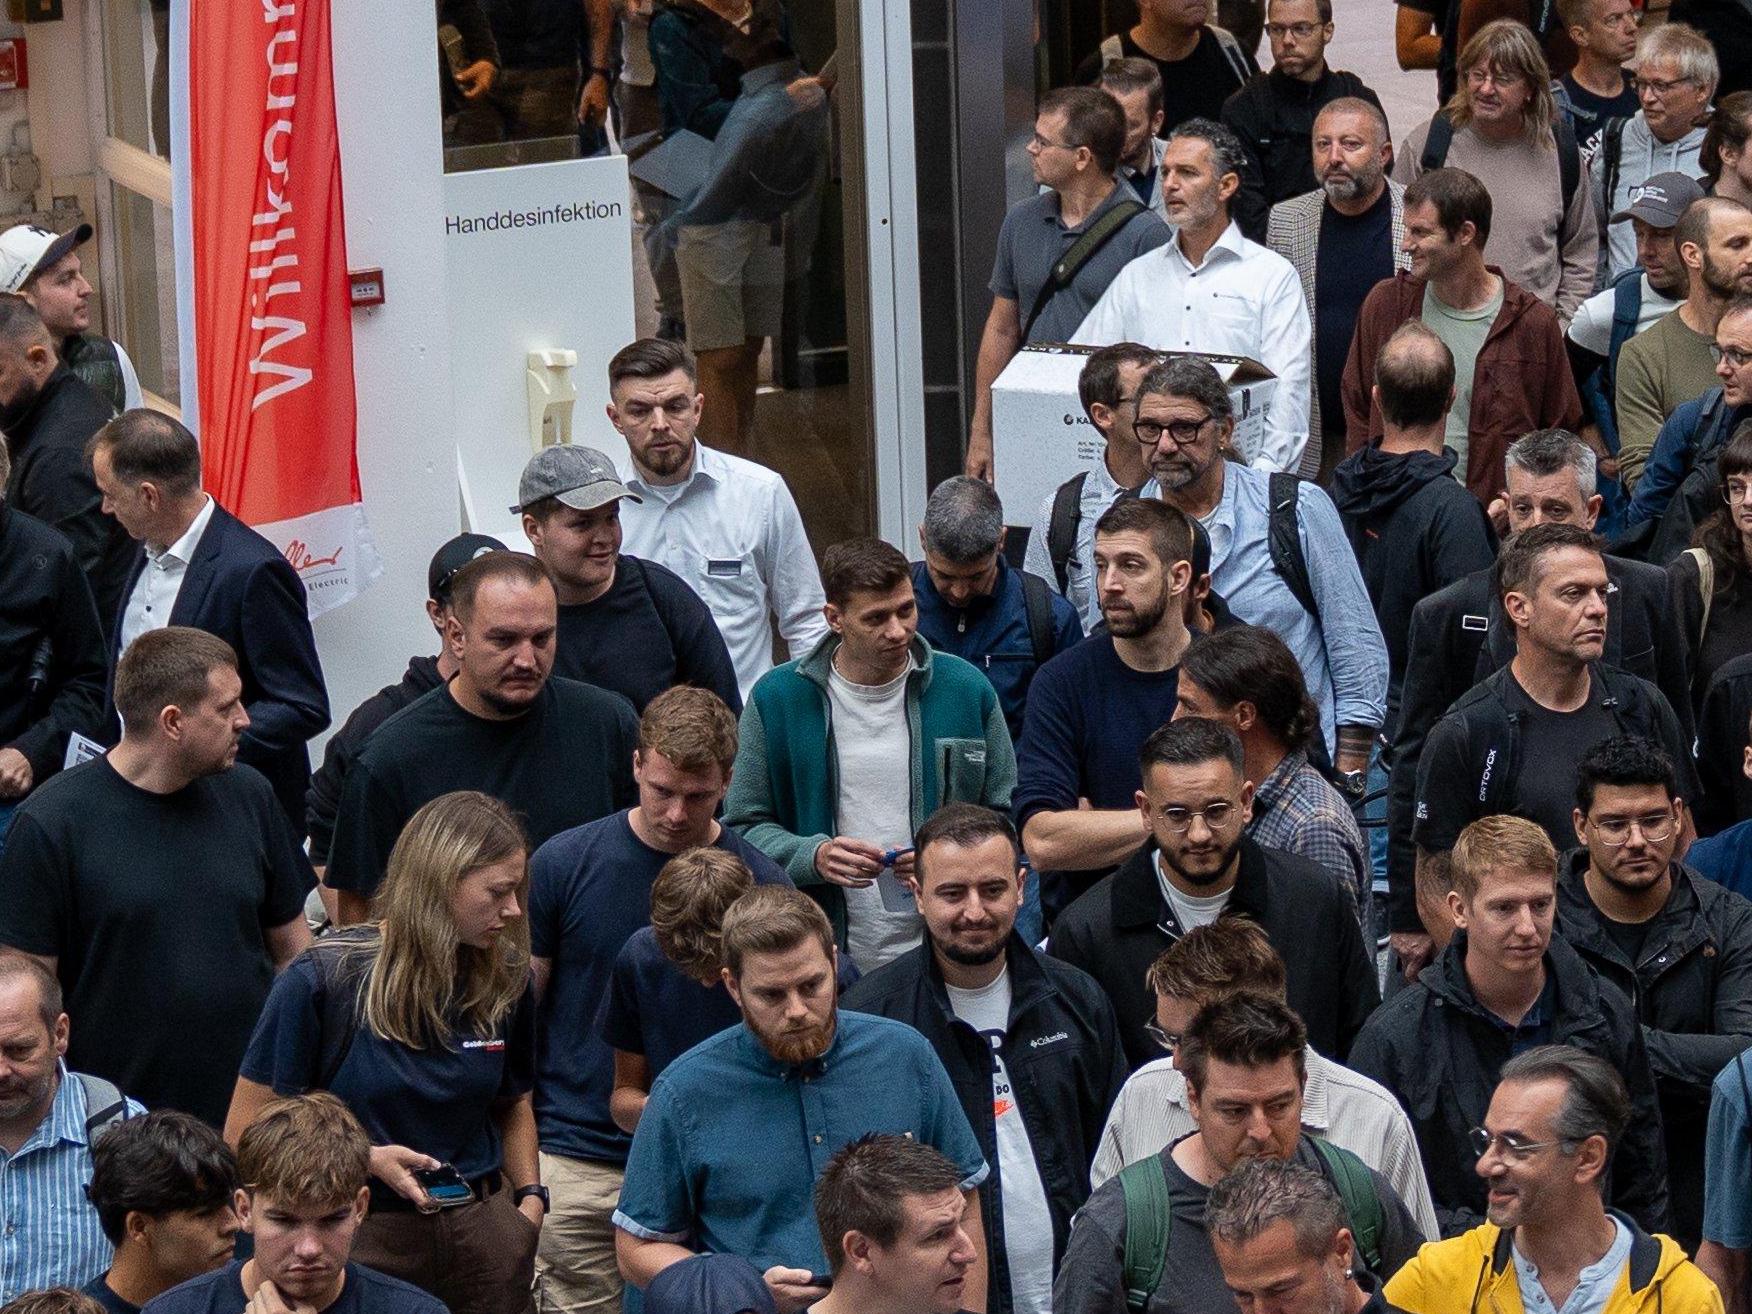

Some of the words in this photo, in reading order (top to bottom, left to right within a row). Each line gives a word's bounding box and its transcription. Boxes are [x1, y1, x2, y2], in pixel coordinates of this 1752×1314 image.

[444, 201, 622, 235] Handdesinfektion
[1479, 749, 1497, 802] ORTOVOX
[1037, 1031, 1069, 1046] Columbia
